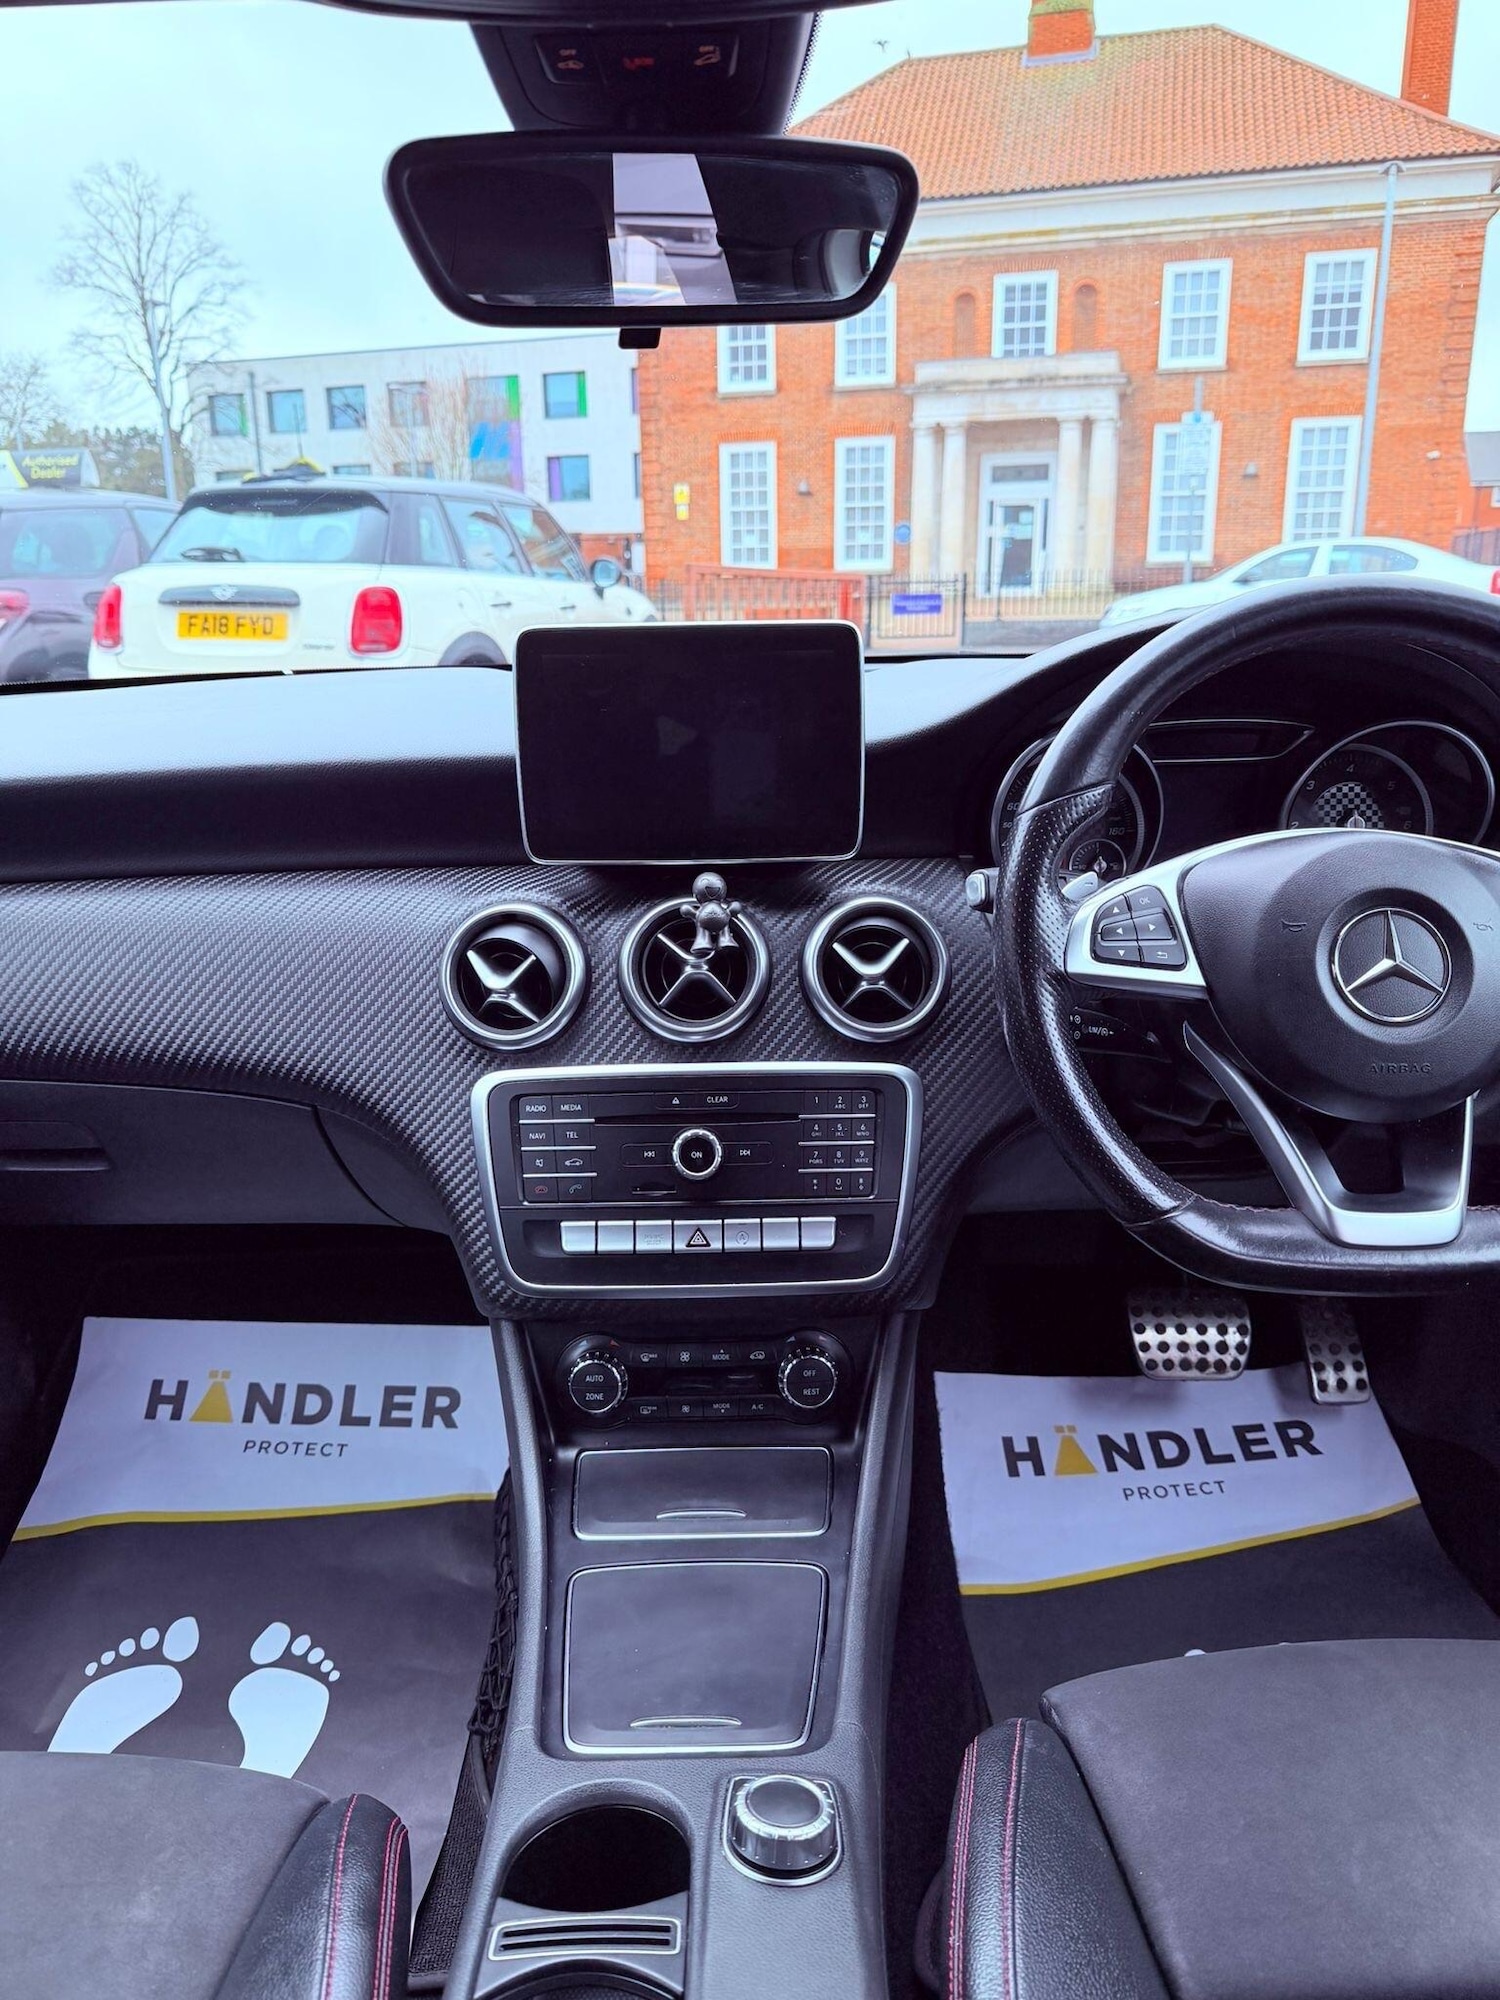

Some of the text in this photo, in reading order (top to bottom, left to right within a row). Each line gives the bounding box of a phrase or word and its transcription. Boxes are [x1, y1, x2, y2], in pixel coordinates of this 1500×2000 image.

[187, 615, 230, 635] FA18
[1306, 780, 1316, 791] 3
[1370, 1062, 1432, 1074] AIRBAG
[814, 1096, 819, 1104] 1
[837, 1095, 843, 1104] 2
[862, 1095, 867, 1103] 3
[525, 1104, 547, 1113] RADIO
[560, 1103, 582, 1111] MEDIA
[813, 1123, 819, 1131] 4
[860, 1123, 866, 1131] 6
[529, 1132, 546, 1140] NAVI
[566, 1131, 579, 1139] TEL
[691, 1151, 703, 1159] ON
[813, 1151, 818, 1159] 7
[836, 1150, 842, 1158] 8
[859, 1150, 865, 1158] 9
[803, 1369, 816, 1377] OFF
[803, 1388, 820, 1396] REST
[144, 1370, 462, 1429] HÄNDLER
[585, 1393, 604, 1401] ZONE
[243, 1440, 348, 1457] PROTECT
[1001, 1420, 1324, 1477] HÄNDLER
[1122, 1480, 1227, 1501] PROTECT
